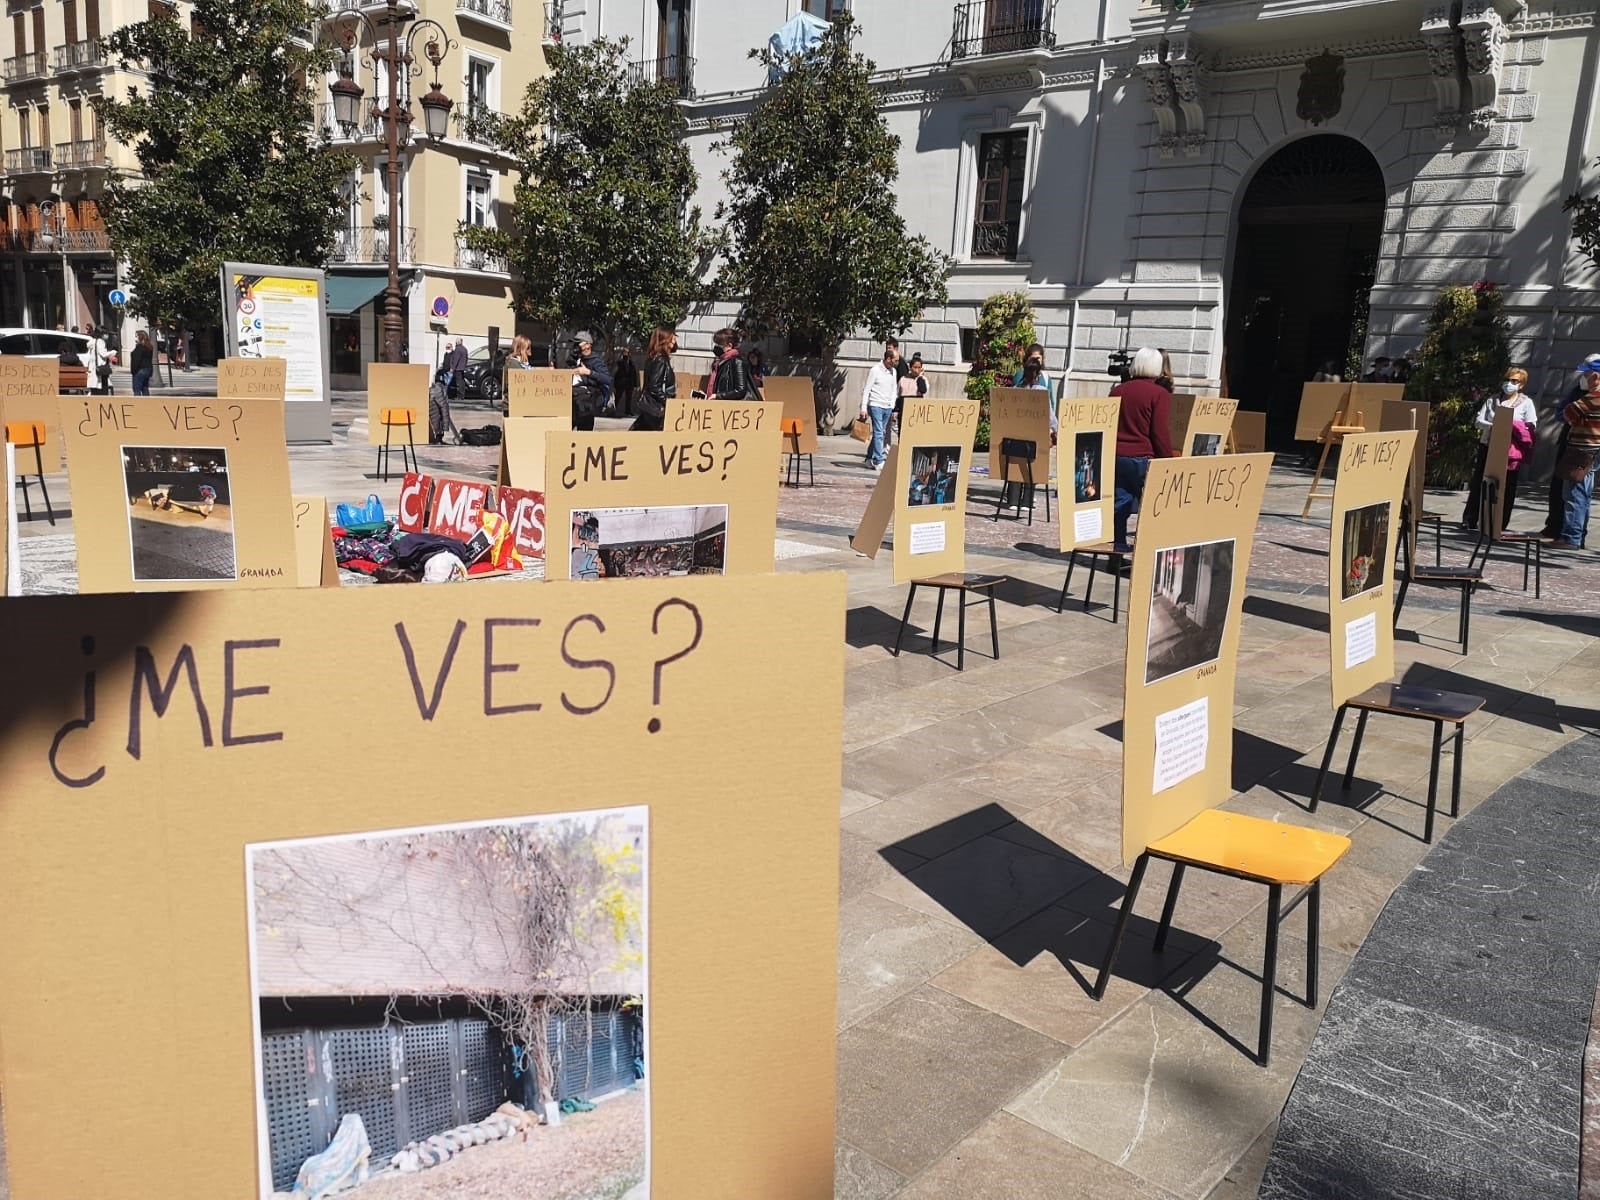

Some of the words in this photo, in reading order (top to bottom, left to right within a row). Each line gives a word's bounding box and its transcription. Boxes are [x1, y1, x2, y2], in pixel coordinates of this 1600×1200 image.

[23, 365, 51, 379] DES
[7, 383, 56, 397] ESPALDA
[78, 402, 138, 438] ¿ME
[163, 404, 244, 441] VES?
[674, 403, 713, 432] ¿ME
[908, 404, 935, 428] ¿ME
[941, 404, 976, 429] VES?
[1061, 402, 1085, 429] ¿ME
[1090, 402, 1118, 429] VES?
[562, 443, 629, 490] ¿ME
[659, 439, 738, 481] VES?
[1343, 441, 1369, 472] ¿ME
[1373, 439, 1401, 472] VES?
[1152, 469, 1197, 518] ¿ME
[1206, 463, 1252, 509] VES?
[240, 567, 284, 578] GRANADA
[48, 635, 284, 788] ¿ME
[394, 598, 704, 734] VES?
